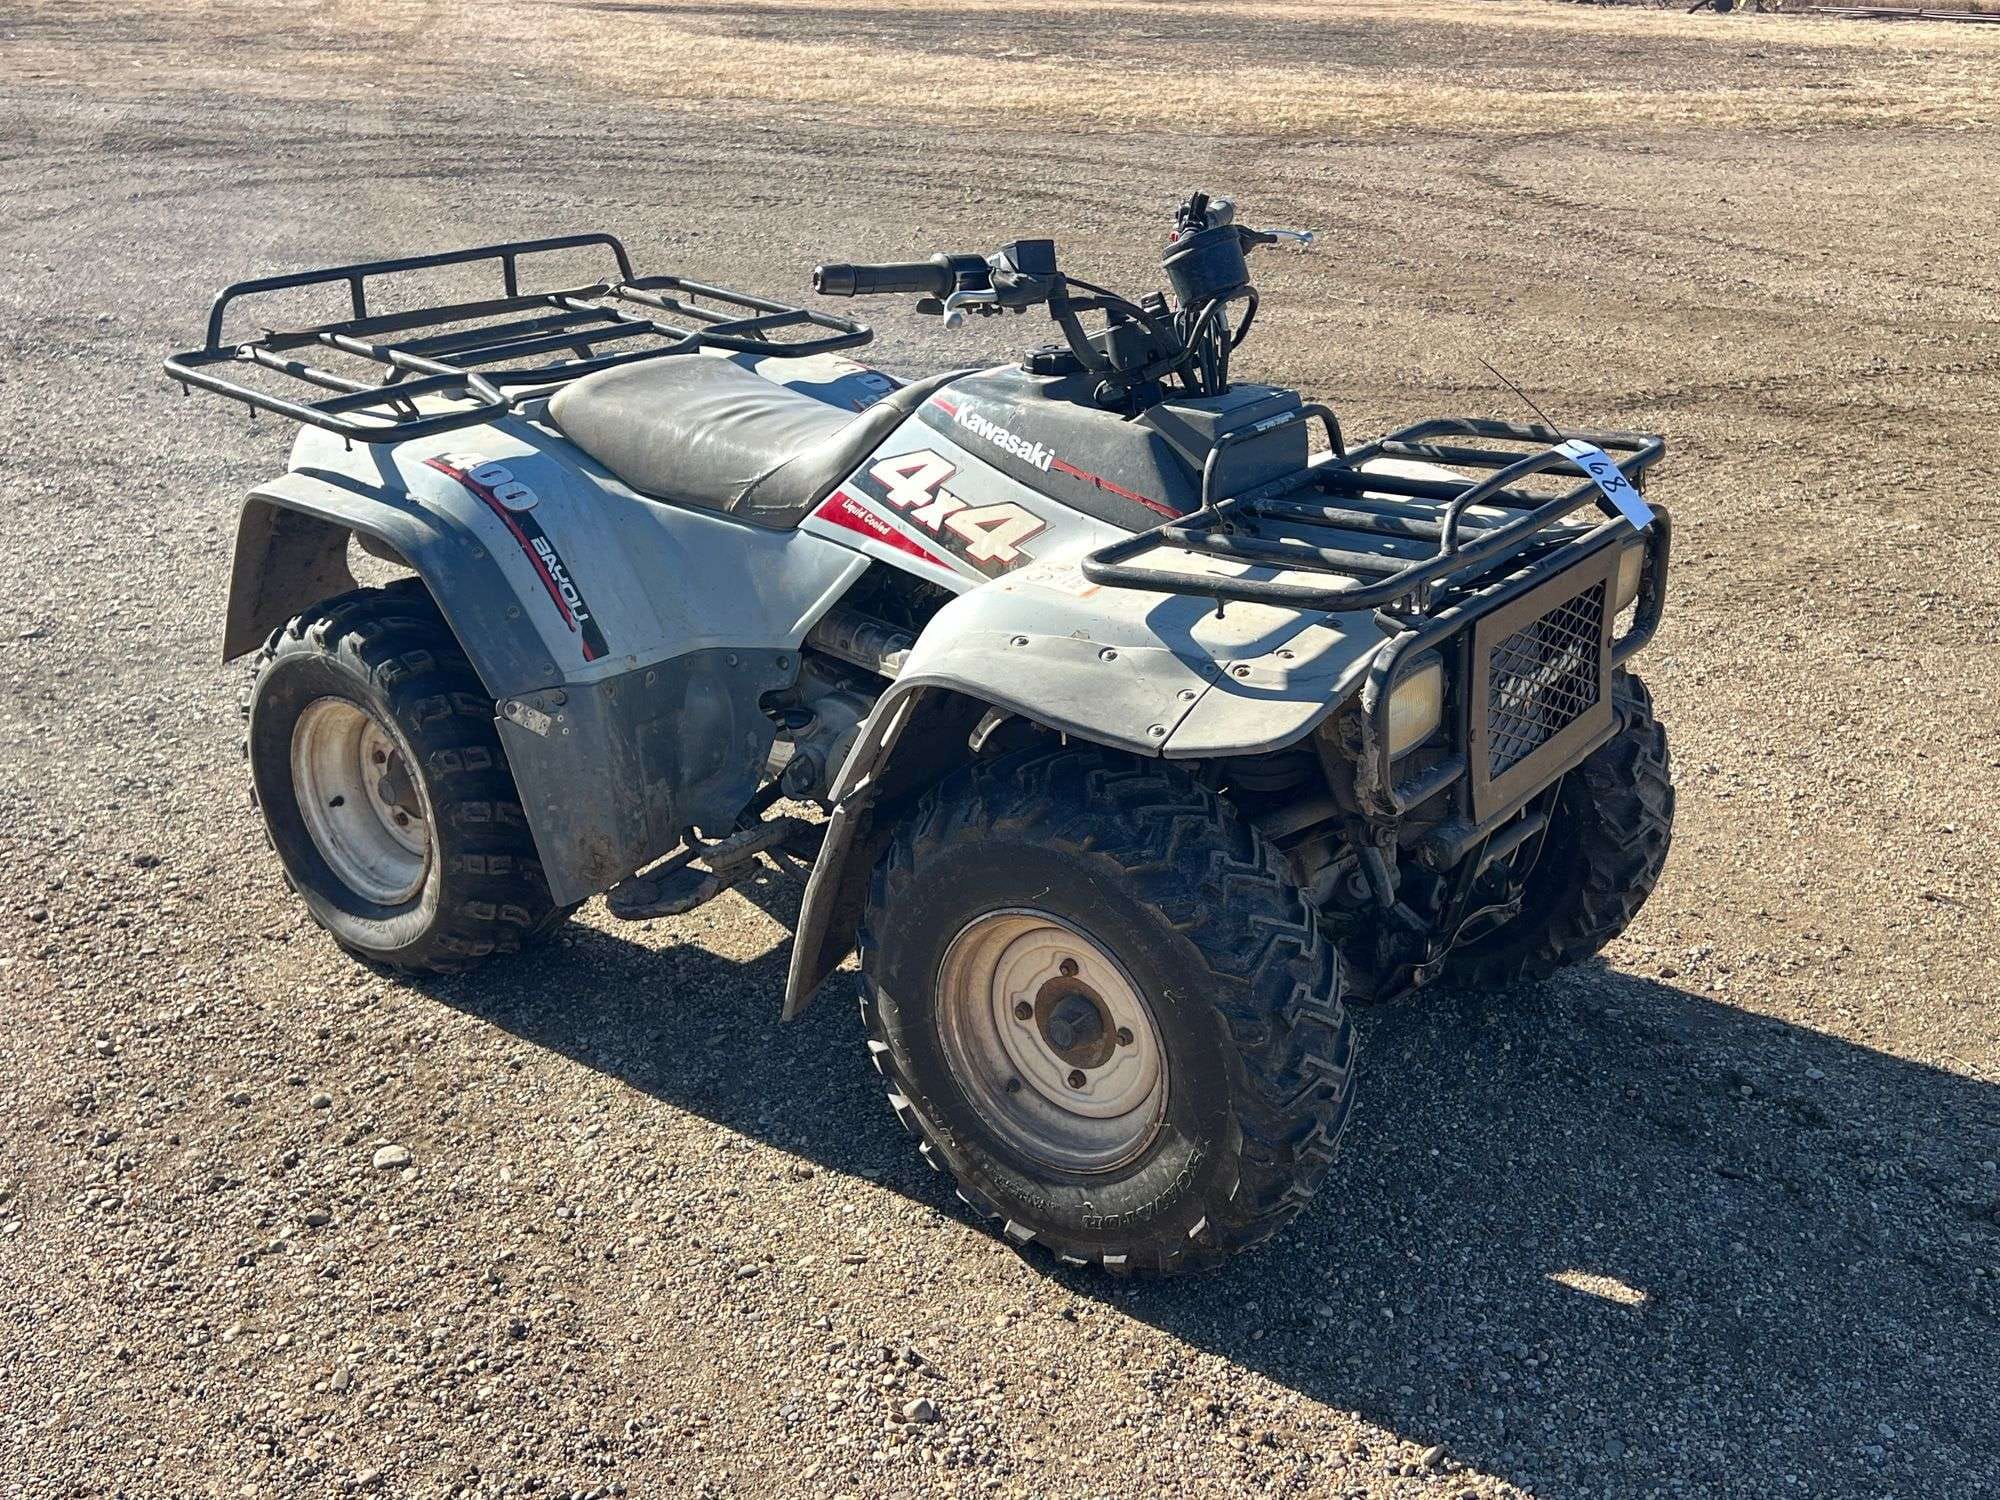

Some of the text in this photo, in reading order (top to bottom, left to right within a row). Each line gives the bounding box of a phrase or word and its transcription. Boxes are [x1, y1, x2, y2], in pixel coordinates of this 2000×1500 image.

[954, 402, 1056, 473] Kawasaki
[440, 451, 539, 512] 400
[1575, 451, 1627, 493] 168
[841, 498, 892, 536] Liquid Cooled
[530, 536, 590, 623] BAYOU
